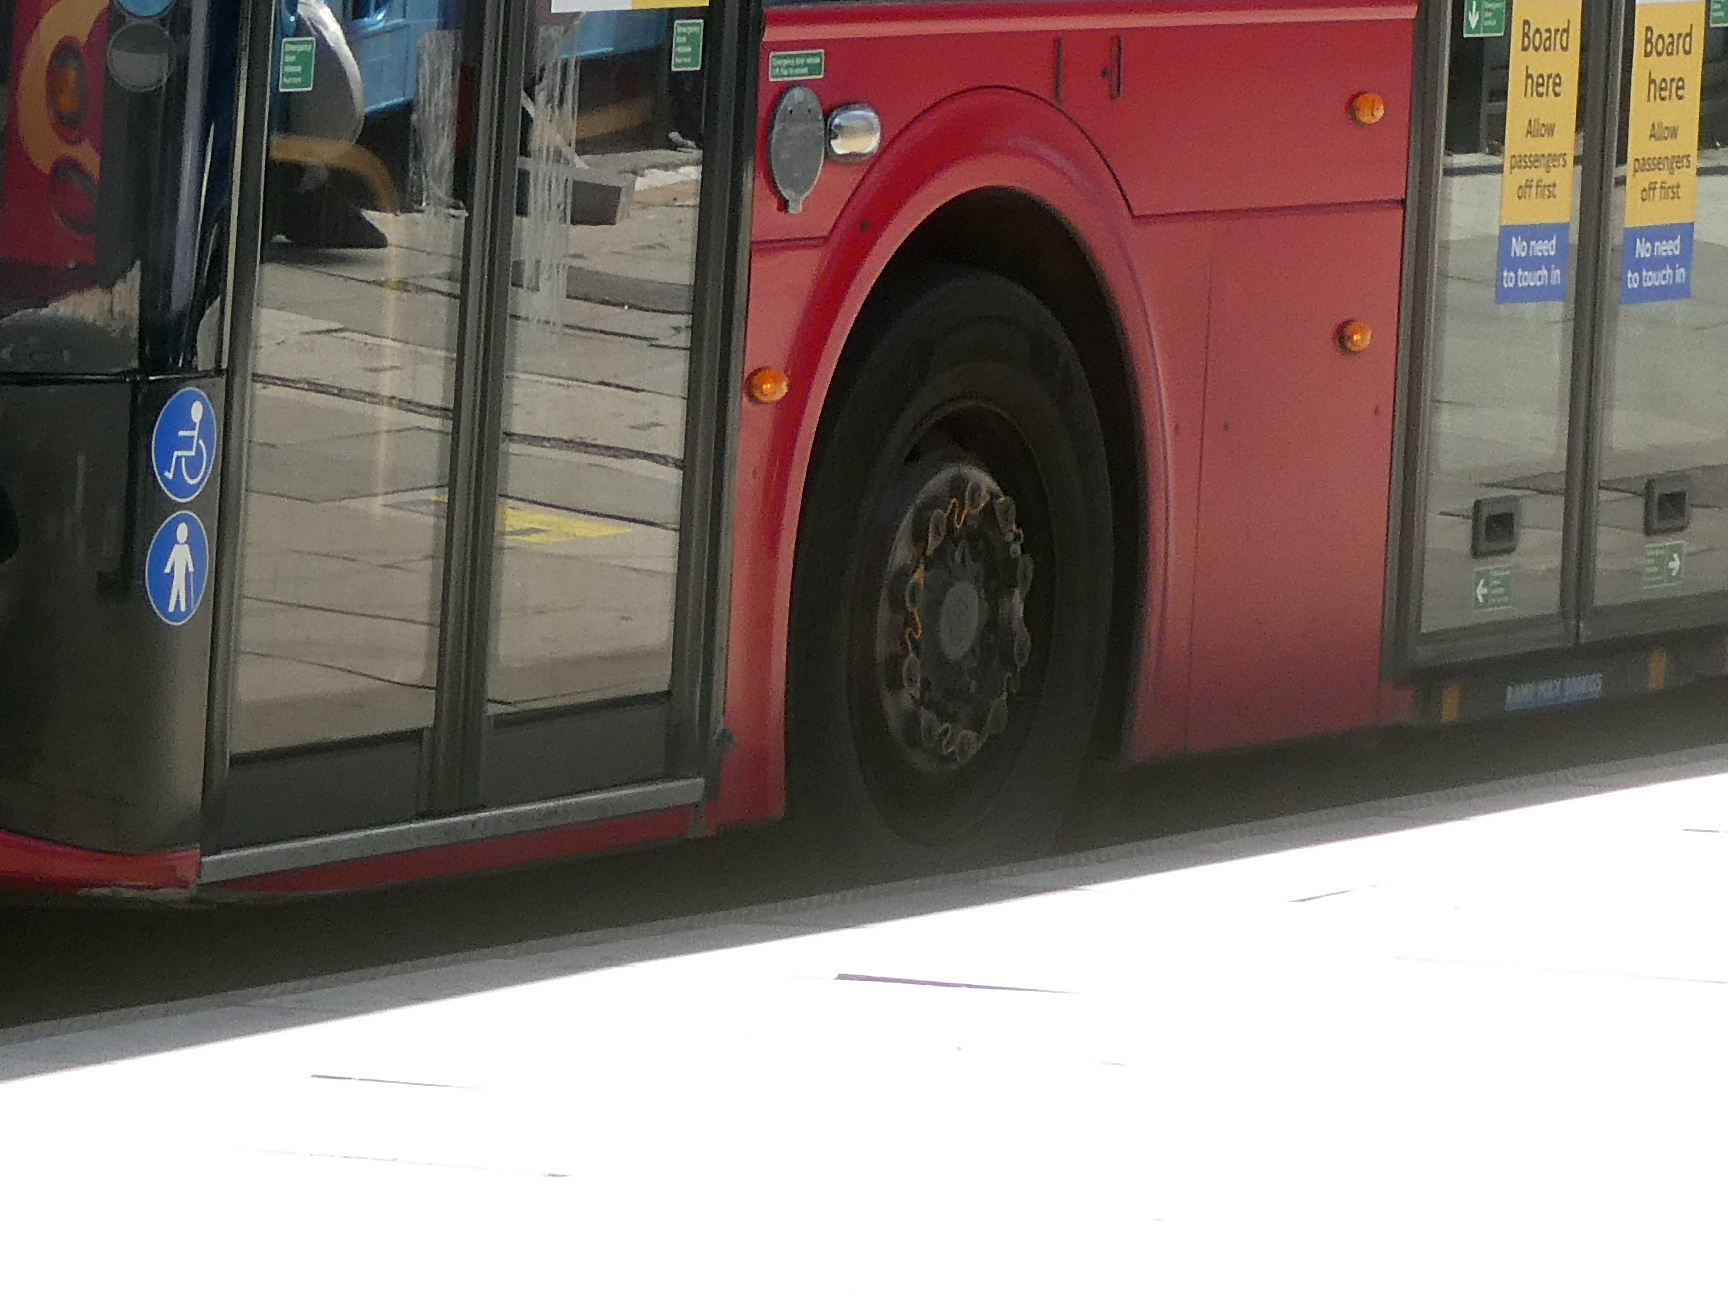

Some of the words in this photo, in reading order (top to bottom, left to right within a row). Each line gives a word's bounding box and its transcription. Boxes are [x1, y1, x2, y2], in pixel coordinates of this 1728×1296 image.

[1521, 19, 1570, 53] Board
[1644, 24, 1693, 59] Board
[1524, 66, 1562, 99] here
[1647, 70, 1685, 103] here
[1526, 117, 1555, 140] Allow
[1649, 121, 1679, 142] Allow
[1510, 150, 1567, 175] passengers
[1633, 152, 1691, 177] passengers
[1516, 178, 1534, 201] off
[1536, 178, 1557, 200] first
[1640, 180, 1658, 202] off
[1659, 179, 1681, 201] first
[1511, 236, 1526, 256] No
[1529, 234, 1556, 256] need
[1635, 237, 1652, 257] No
[1654, 235, 1681, 256] need
[1503, 270, 1514, 288] to
[1516, 267, 1548, 288] touch
[1550, 267, 1561, 285] in
[1627, 270, 1639, 288] to
[1640, 266, 1673, 288] touch
[1675, 266, 1686, 285] in
